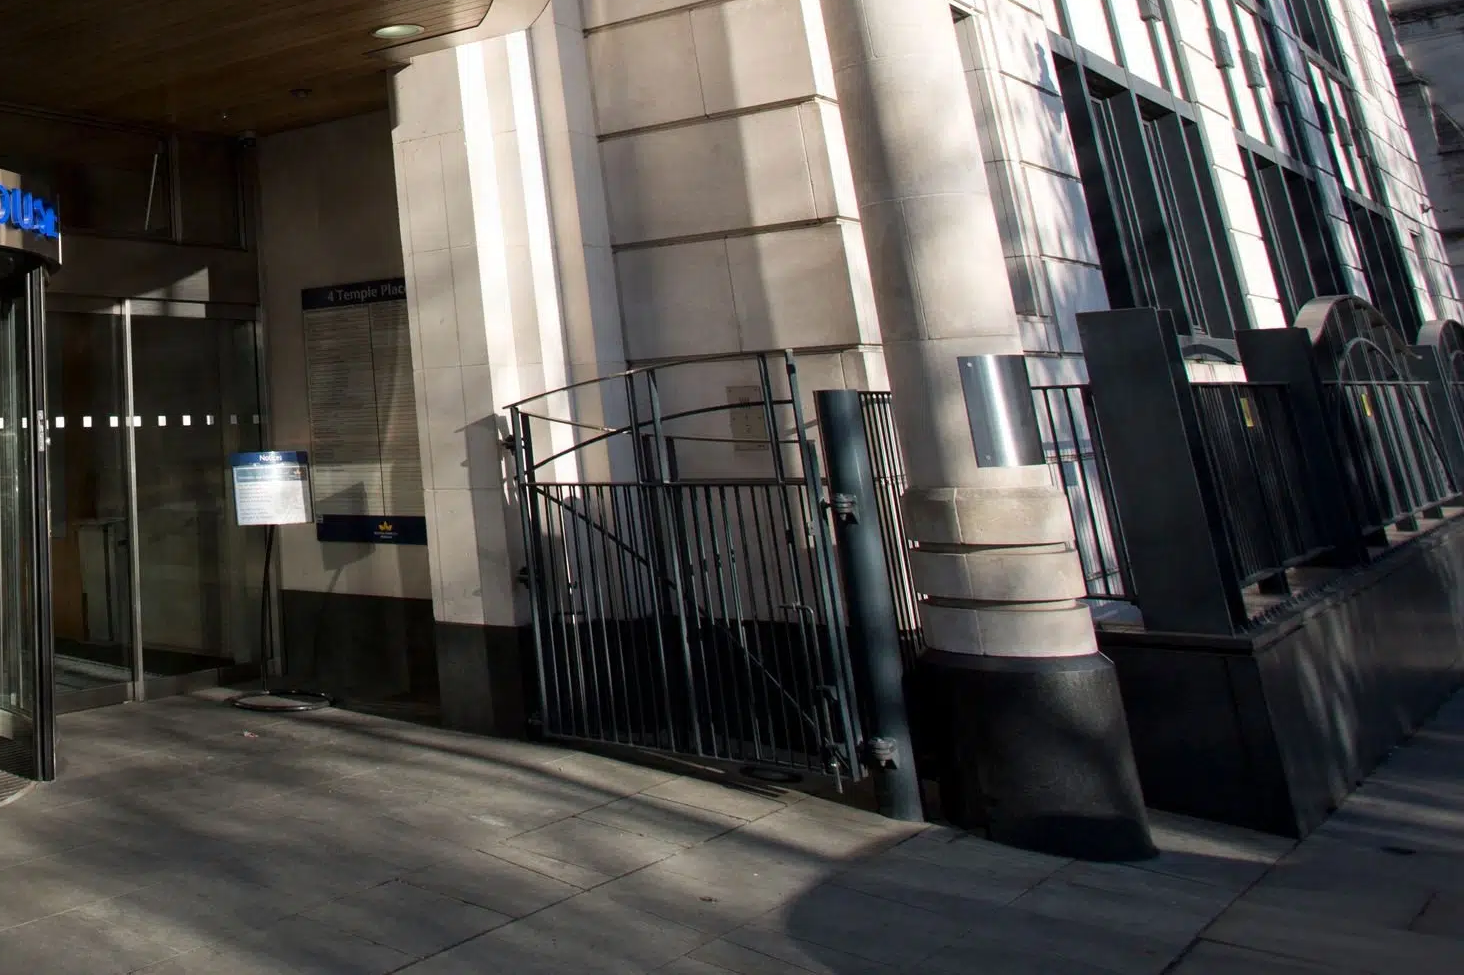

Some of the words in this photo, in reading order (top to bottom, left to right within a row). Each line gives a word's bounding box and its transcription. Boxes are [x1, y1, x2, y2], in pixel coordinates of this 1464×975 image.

[327, 288, 335, 303] 4
[335, 286, 377, 302] Temple
[380, 282, 406, 297] Plac
